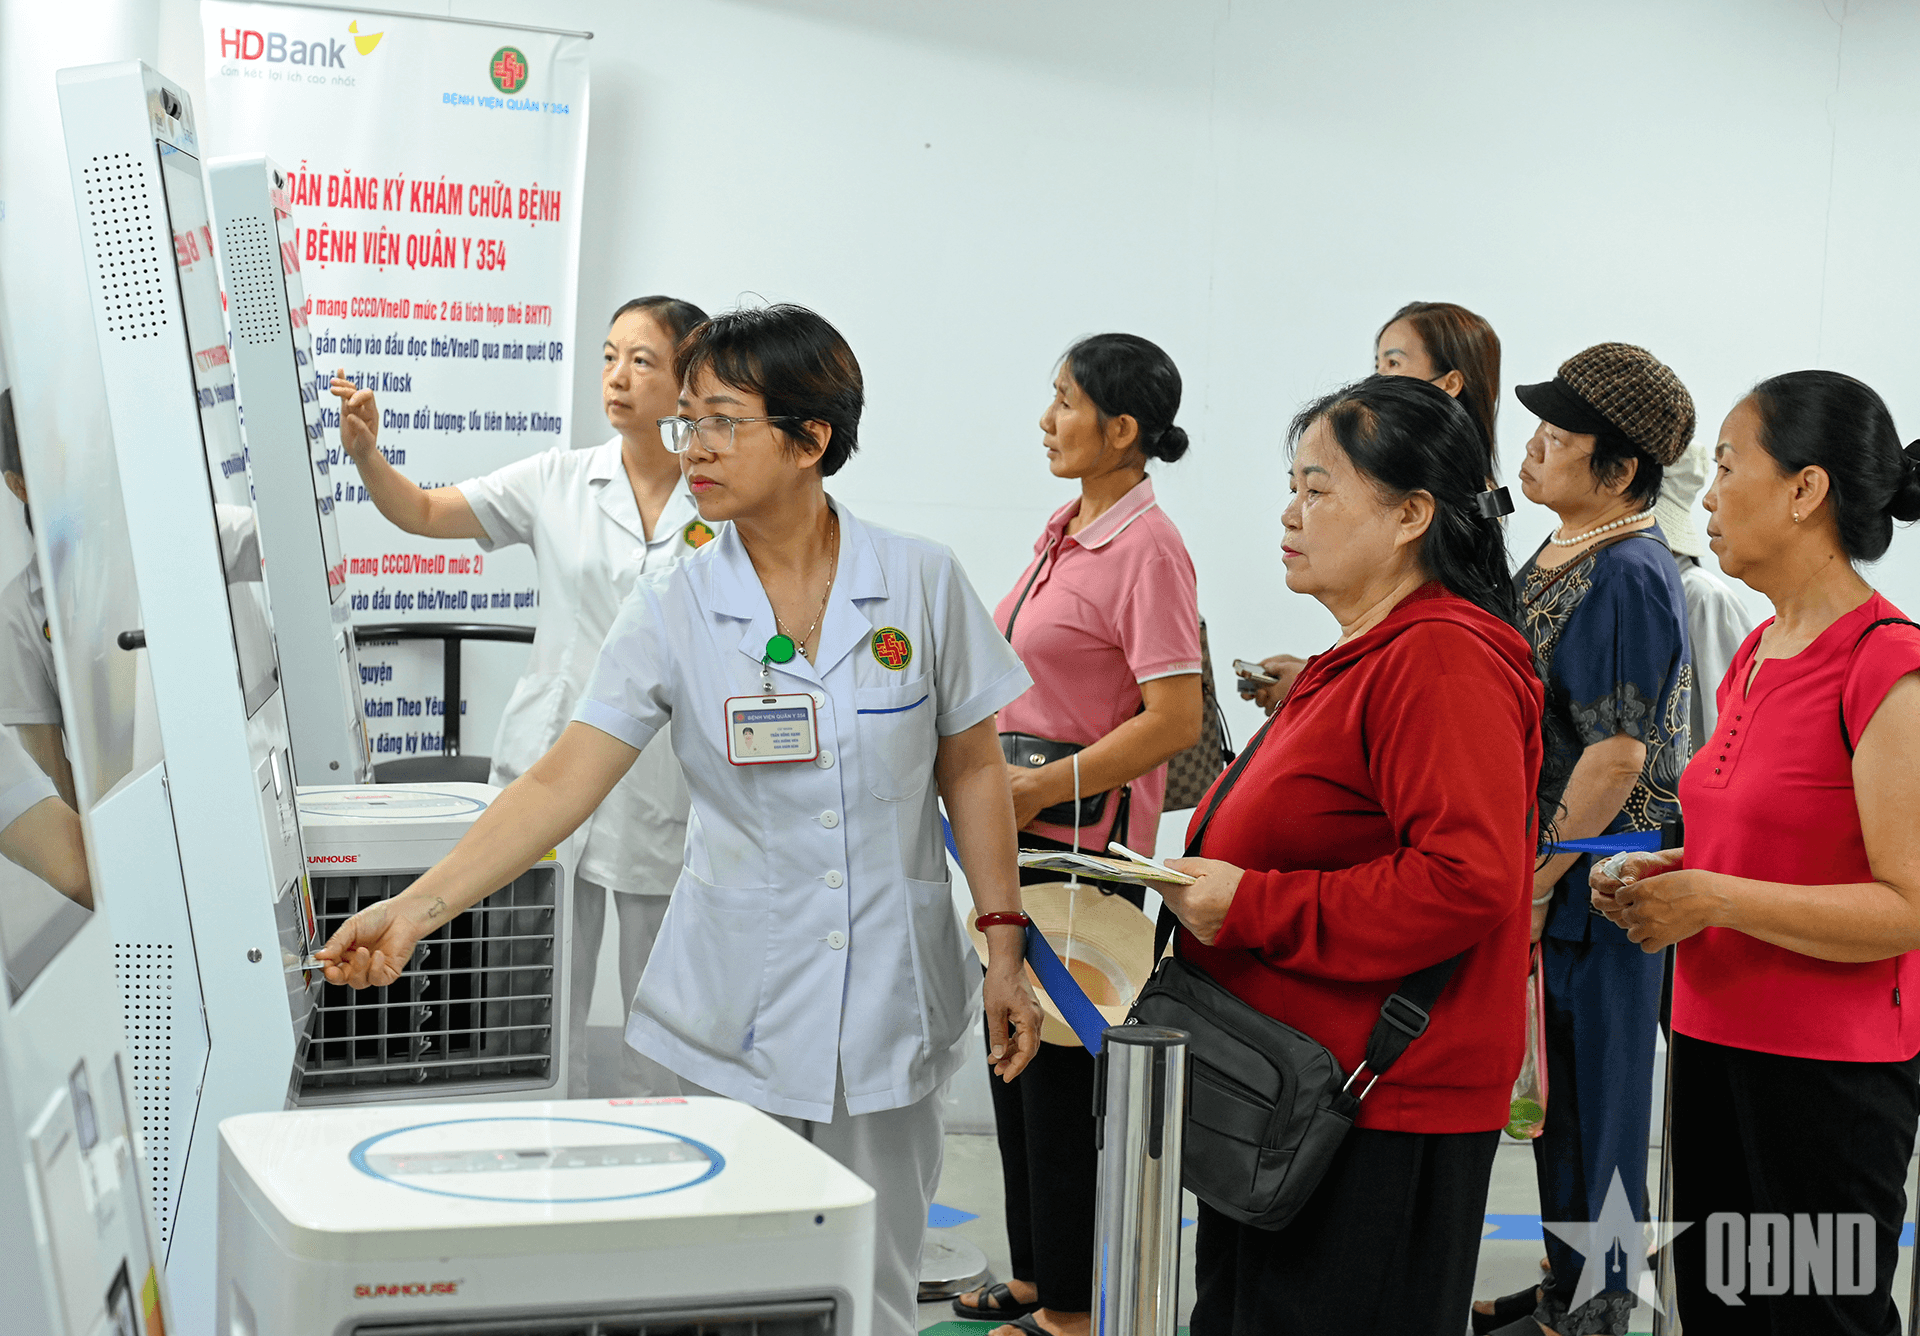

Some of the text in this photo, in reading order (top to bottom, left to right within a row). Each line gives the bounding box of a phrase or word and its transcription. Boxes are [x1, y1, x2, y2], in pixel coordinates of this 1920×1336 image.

[220, 27, 347, 69] HDBank
[221, 64, 239, 76] Cam
[269, 69, 282, 81] lợi
[287, 69, 302, 81] ích
[307, 74, 326, 84] cao
[443, 92, 570, 114] BỆNH VIỆN QUÂN Y 354
[287, 159, 561, 228] DẪN ĐĂNG KÝ KHÁM CHỮA BỆNH
[306, 221, 357, 270] BỆNH
[363, 225, 400, 272] VIỆN
[406, 228, 456, 271] QUÂN
[462, 237, 472, 269] Y
[476, 238, 506, 271] 354
[316, 298, 348, 319] mang
[351, 296, 410, 319] CCCD/VneID
[413, 299, 437, 320] mức
[440, 301, 447, 321] 2
[450, 301, 462, 321] đã
[465, 301, 484, 322] tích
[487, 303, 504, 328] hợp
[316, 328, 336, 356] gắn
[340, 333, 362, 357] chíp
[365, 333, 382, 354] vào
[407, 336, 427, 361] đọc
[482, 342, 499, 361] qua
[548, 341, 563, 363] QR
[382, 371, 412, 392] Kiosk
[320, 407, 341, 428] Khá
[383, 408, 410, 433] Chọn
[484, 410, 502, 431] tiên
[505, 411, 528, 436] hoặc
[530, 411, 562, 435] Không
[334, 482, 342, 502] &
[346, 482, 355, 501] in
[350, 557, 379, 577] mang
[382, 554, 445, 574] CCCD/VneID
[448, 553, 471, 574] mức
[473, 554, 484, 576] 2)
[351, 589, 369, 610] vào
[394, 589, 414, 614] đọc
[470, 593, 488, 612] qua
[358, 661, 393, 686] guyện
[364, 696, 393, 718] khám
[396, 697, 422, 717] Theo
[377, 732, 403, 755] đăng
[405, 731, 418, 754] ký
[421, 731, 445, 751] khá
[307, 854, 357, 864] UNHOUSE
[355, 1282, 457, 1299] SUNHOUSE
